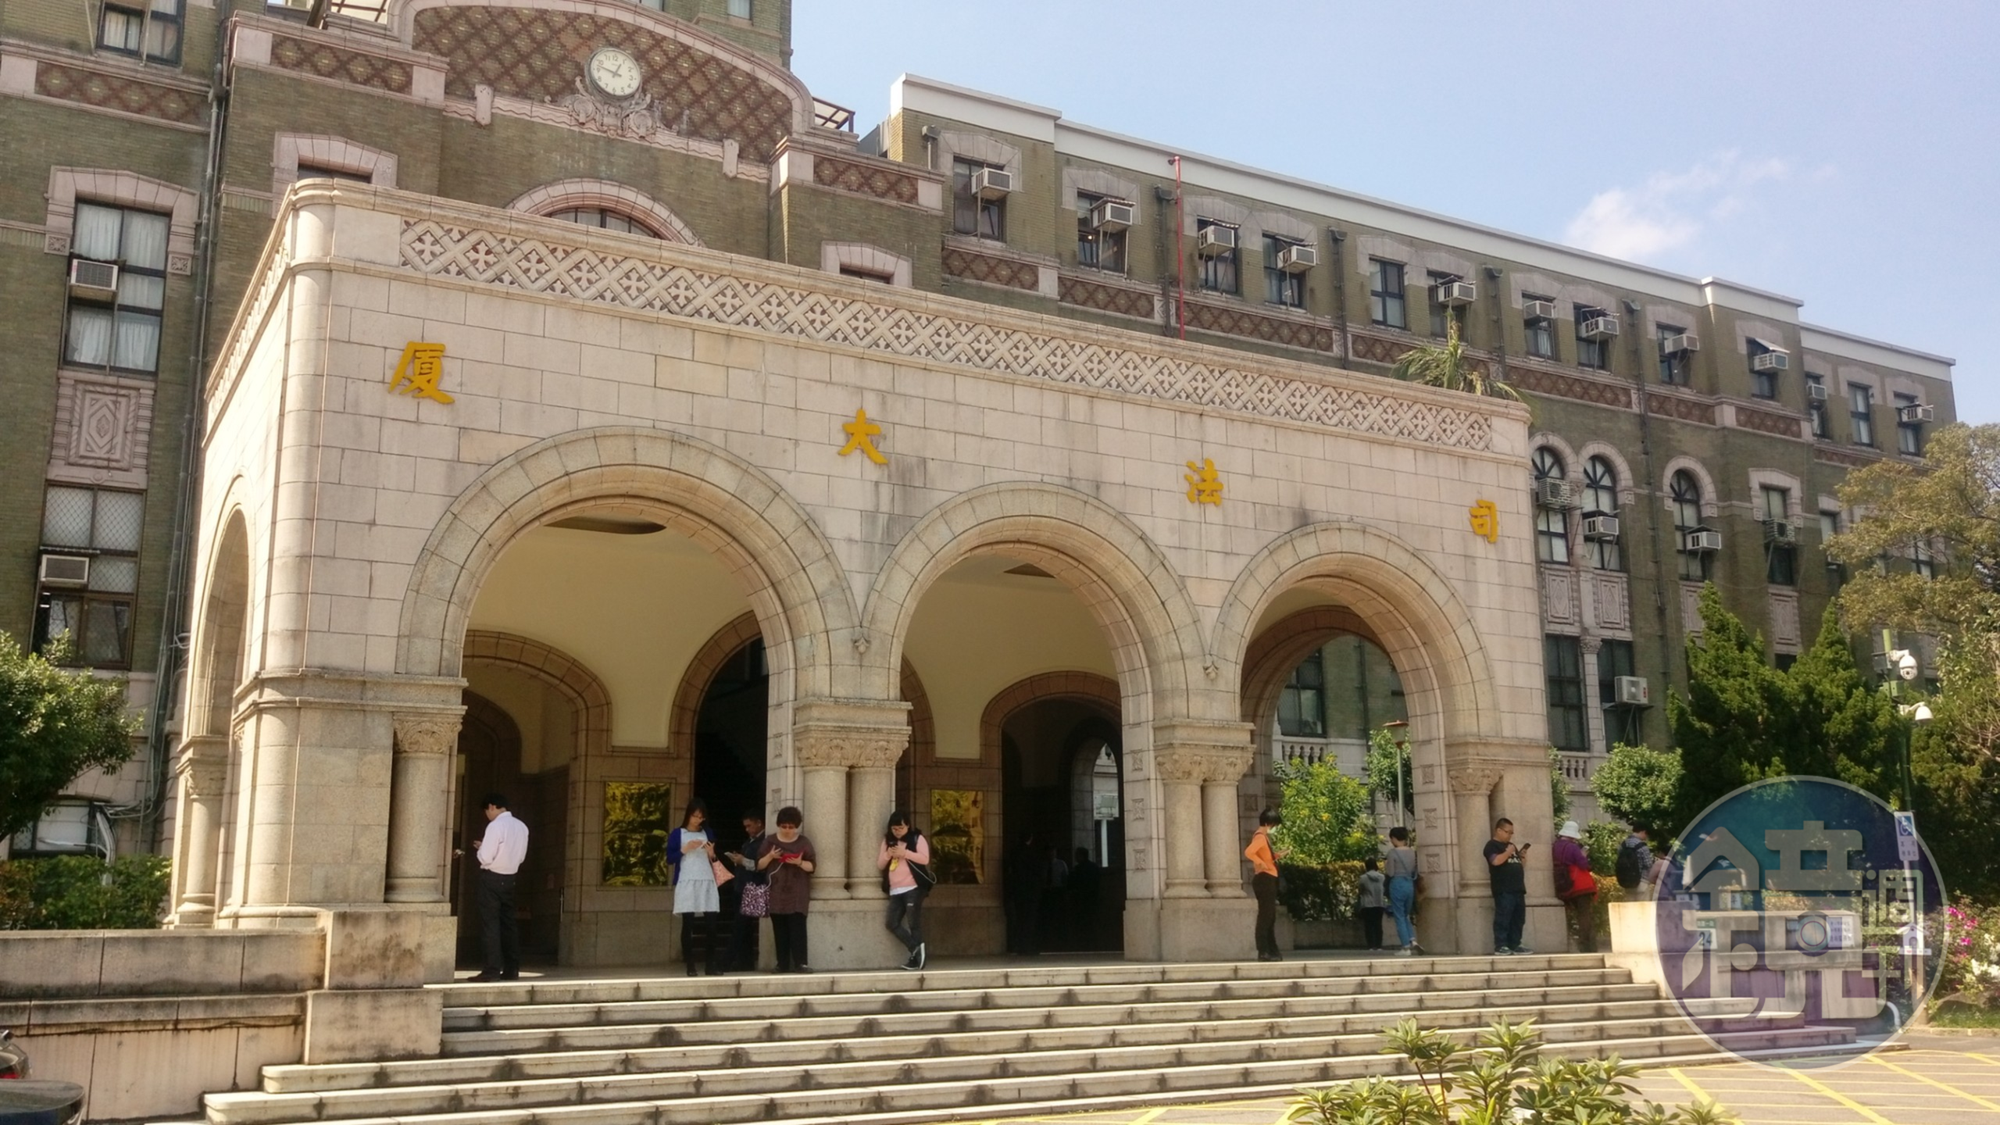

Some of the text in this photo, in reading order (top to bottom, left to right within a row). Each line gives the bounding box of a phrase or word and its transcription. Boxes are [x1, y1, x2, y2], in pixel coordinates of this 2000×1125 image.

[837, 408, 889, 466] 大
[1184, 458, 1224, 507] 法
[1468, 499, 1499, 544] 司
